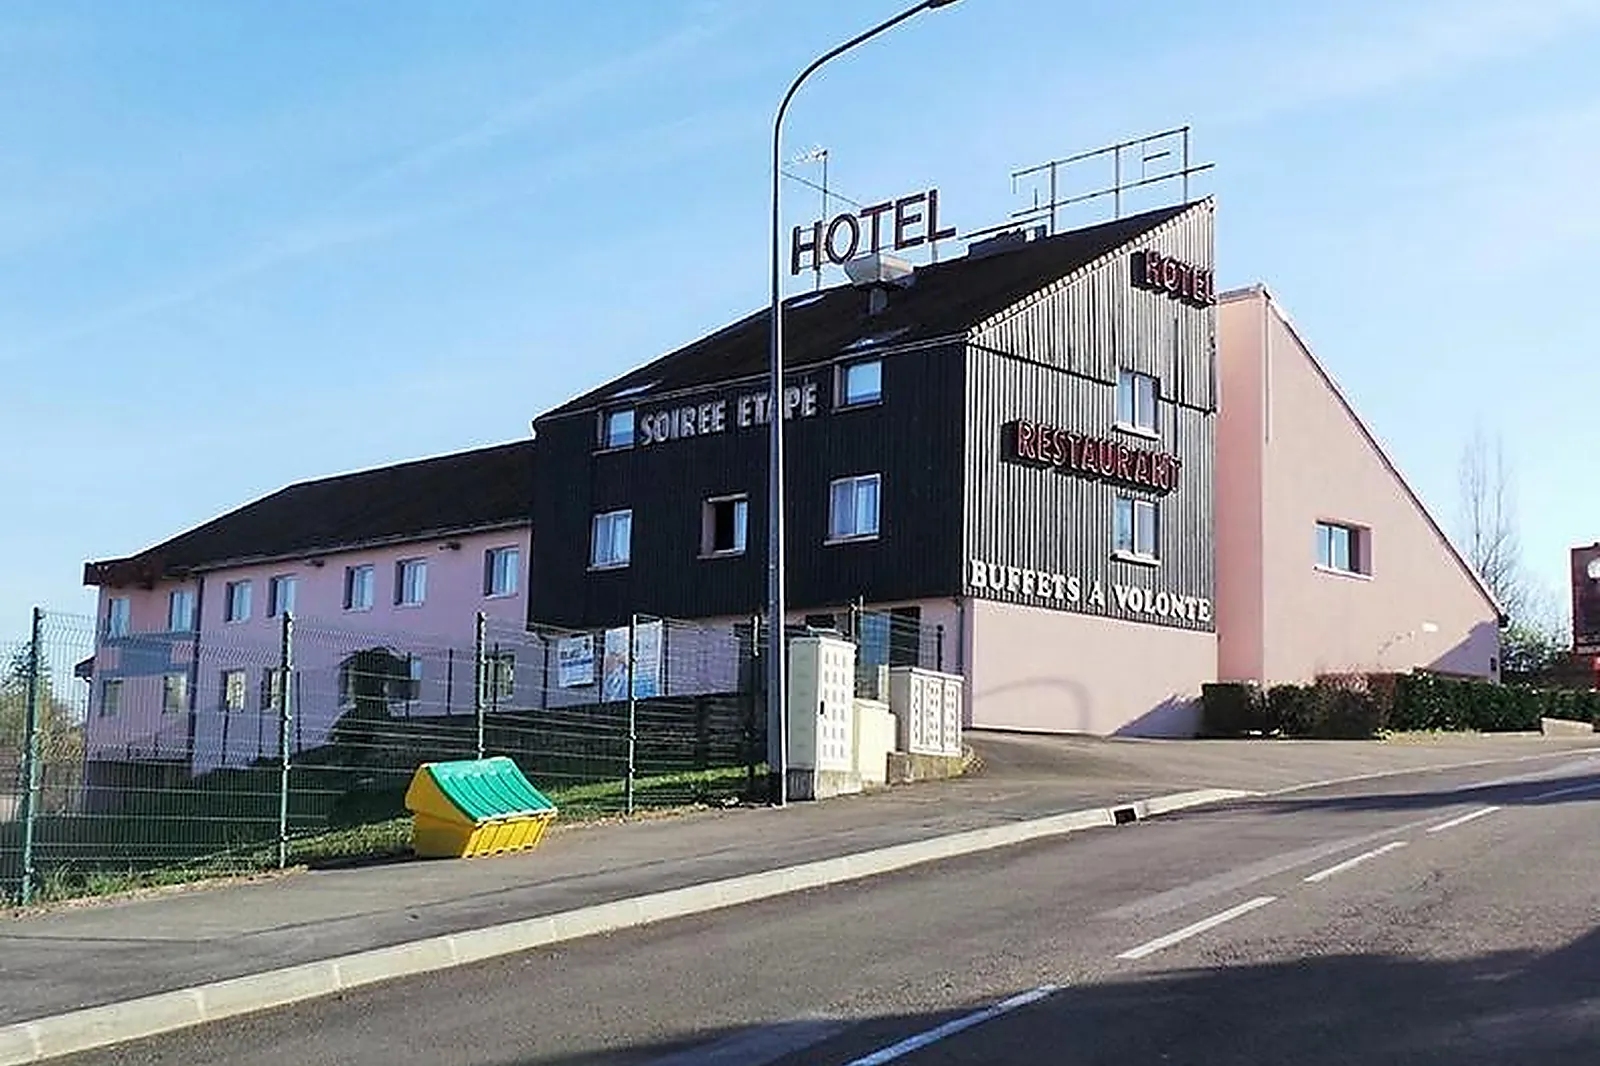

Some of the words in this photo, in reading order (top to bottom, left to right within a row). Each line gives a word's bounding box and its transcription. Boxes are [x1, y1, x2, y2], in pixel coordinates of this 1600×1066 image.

[791, 189, 957, 276] HOTEL
[1145, 250, 1216, 305] HOTEL
[640, 401, 726, 446] SOIREE
[1018, 420, 1182, 491] RESTAURANT
[970, 559, 1081, 602] BUFFETS
[1088, 581, 1106, 607] A
[1114, 584, 1213, 621] VOLONTE
